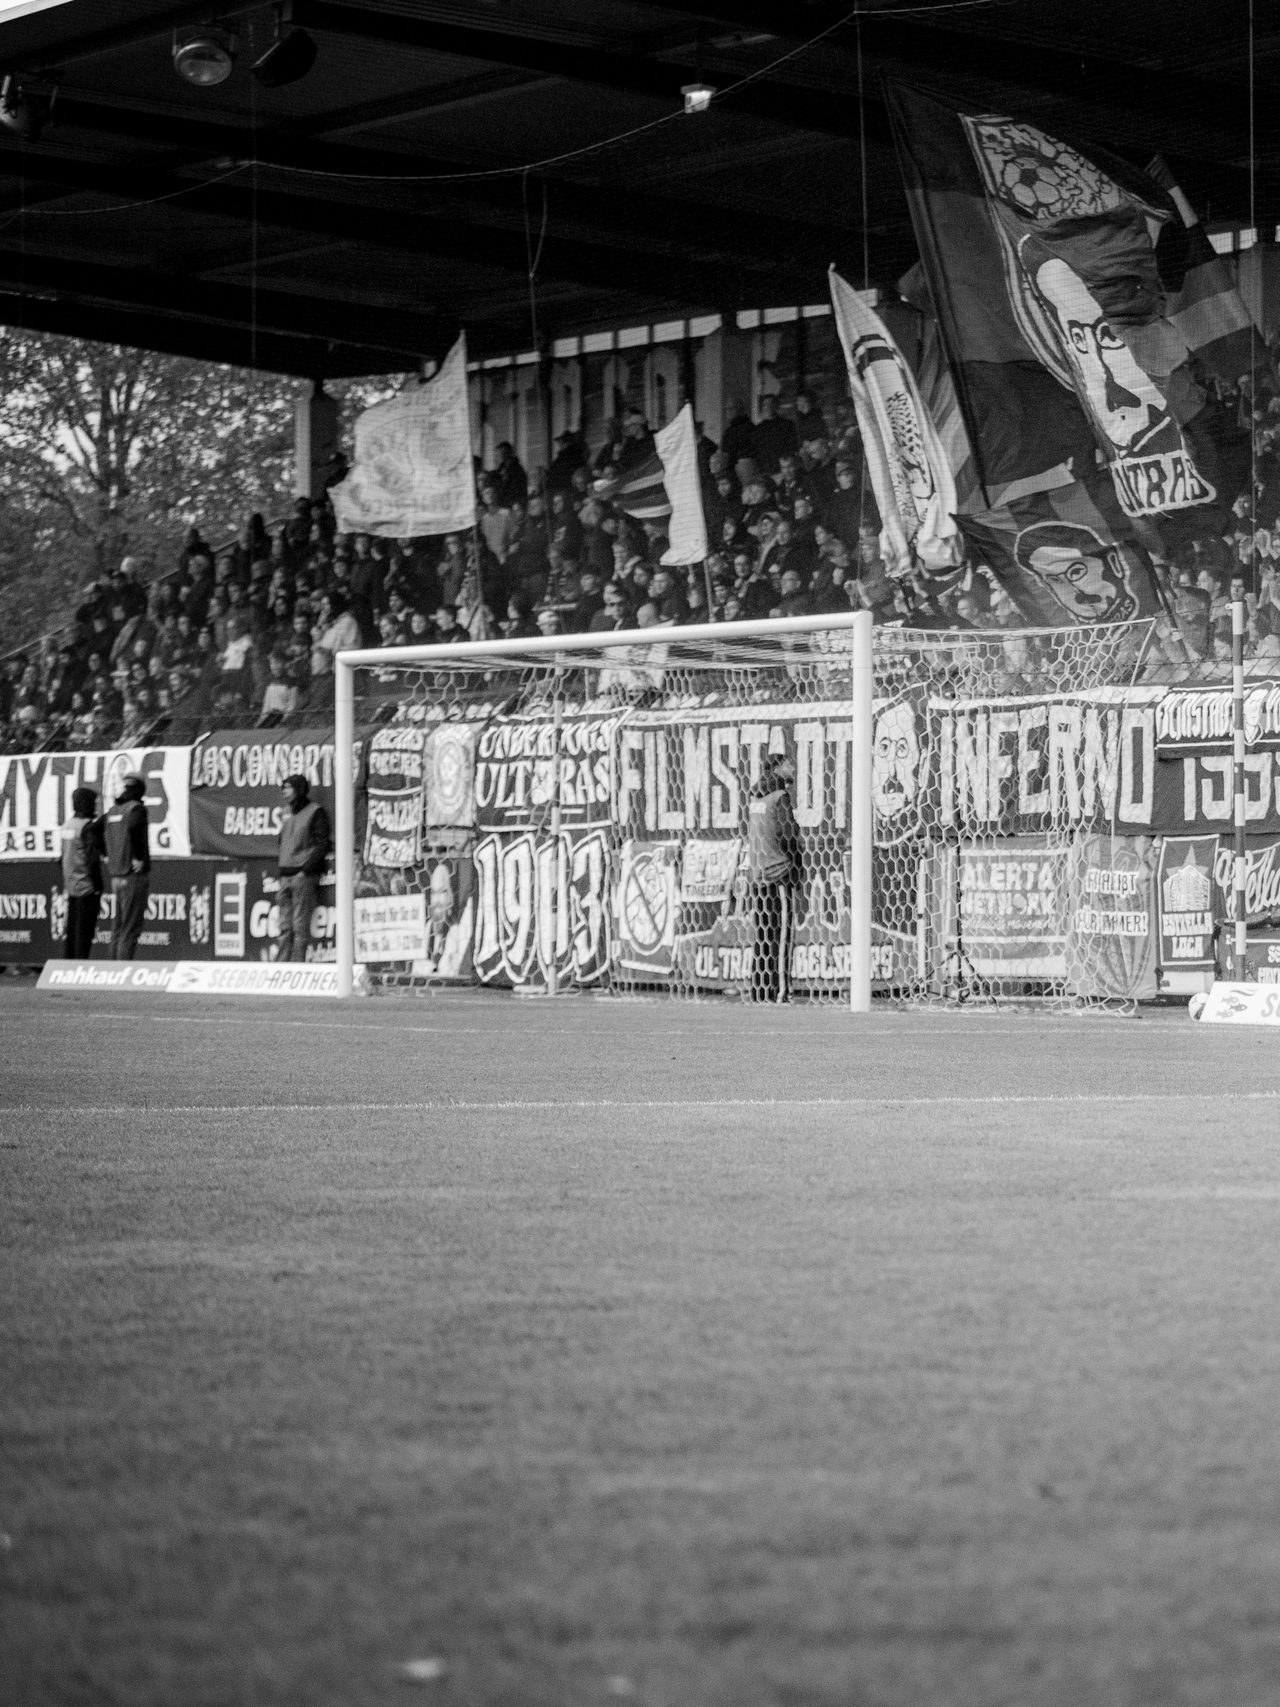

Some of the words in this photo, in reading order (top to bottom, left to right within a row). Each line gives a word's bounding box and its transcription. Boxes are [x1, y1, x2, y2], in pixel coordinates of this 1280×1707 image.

[232, 741, 363, 788] CONSORTS
[940, 703, 1154, 824] INFERNO
[49, 965, 133, 987] nahkauf
[208, 967, 340, 991] SEEBAD-APOTHE
